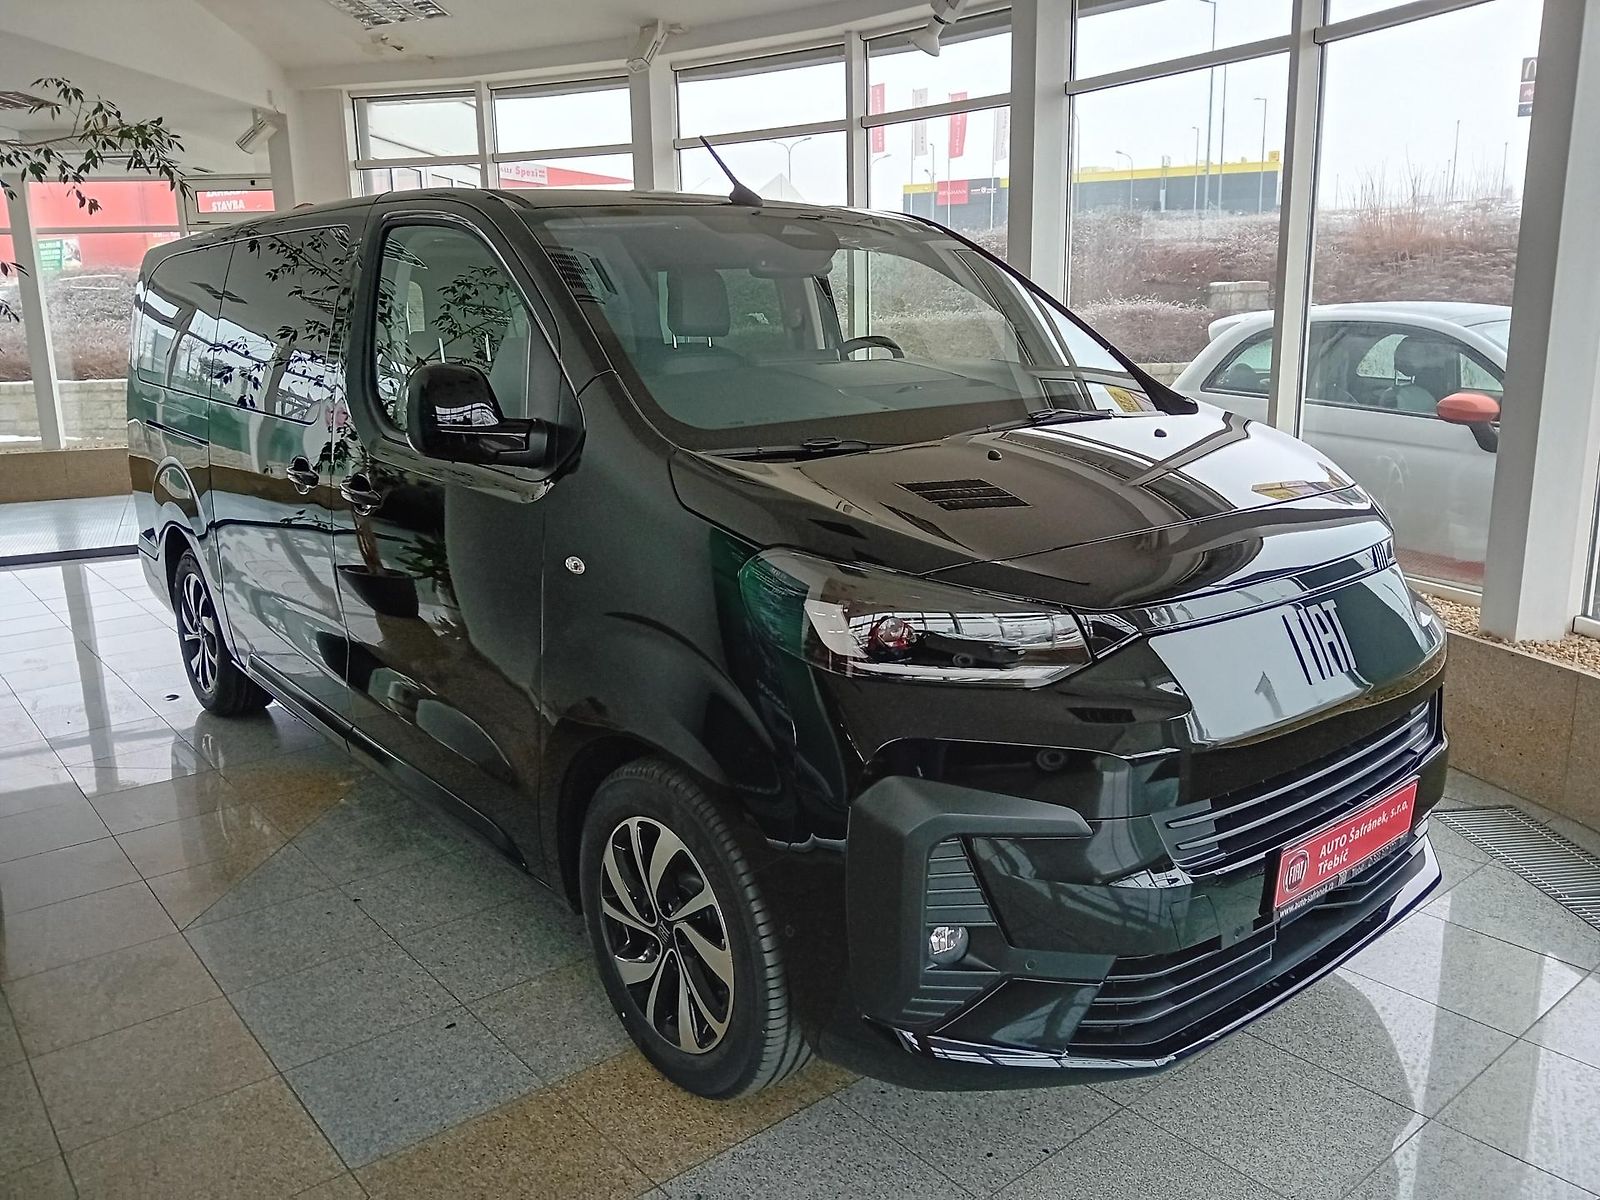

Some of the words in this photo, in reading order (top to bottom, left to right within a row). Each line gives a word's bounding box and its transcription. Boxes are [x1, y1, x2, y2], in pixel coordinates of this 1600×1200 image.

[212, 199, 245, 212] STAVBA
[1319, 834, 1346, 859] AUTO
[1349, 810, 1389, 843] Šafránek,
[1390, 800, 1408, 819] s.r.o.
[1289, 861, 1305, 885] FIAT
[1317, 848, 1349, 876] Třebíč
